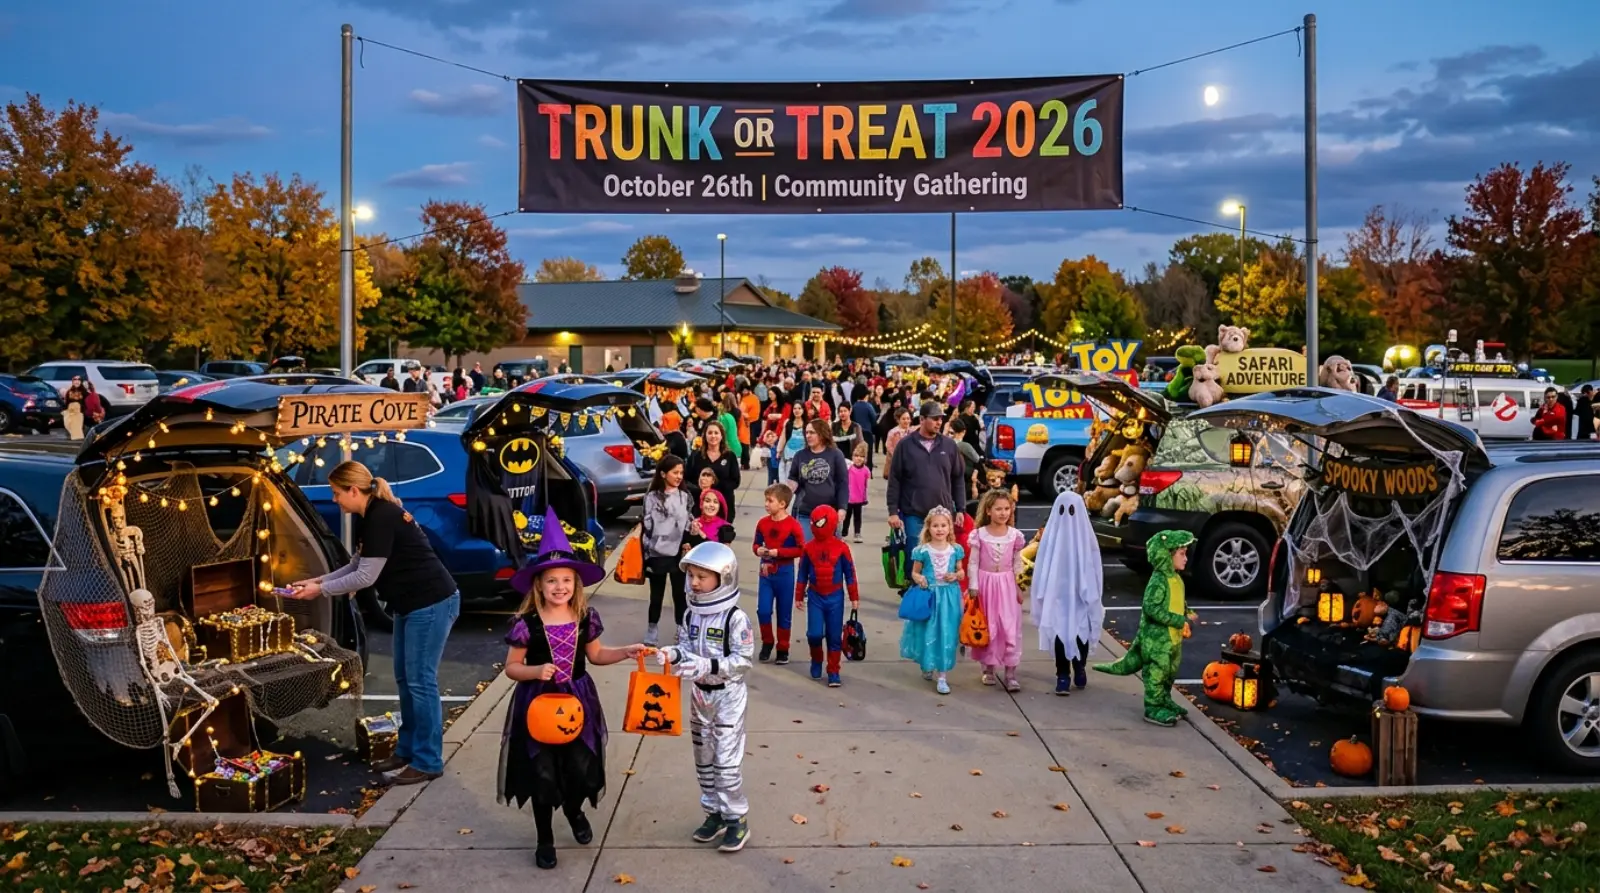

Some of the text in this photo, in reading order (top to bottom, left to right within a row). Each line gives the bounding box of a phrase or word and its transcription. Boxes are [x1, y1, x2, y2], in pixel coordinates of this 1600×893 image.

[538, 99, 1103, 160] TRUNK OR TREAT 2026
[603, 172, 1028, 201] October 26th Community Gathering
[1071, 341, 1138, 373] TOY
[1238, 356, 1293, 371] SAFARI
[1226, 372, 1306, 386] ADVENTURE
[290, 399, 418, 428] PIRATE COVE
[1325, 460, 1438, 495] SPOOKY WOODS
